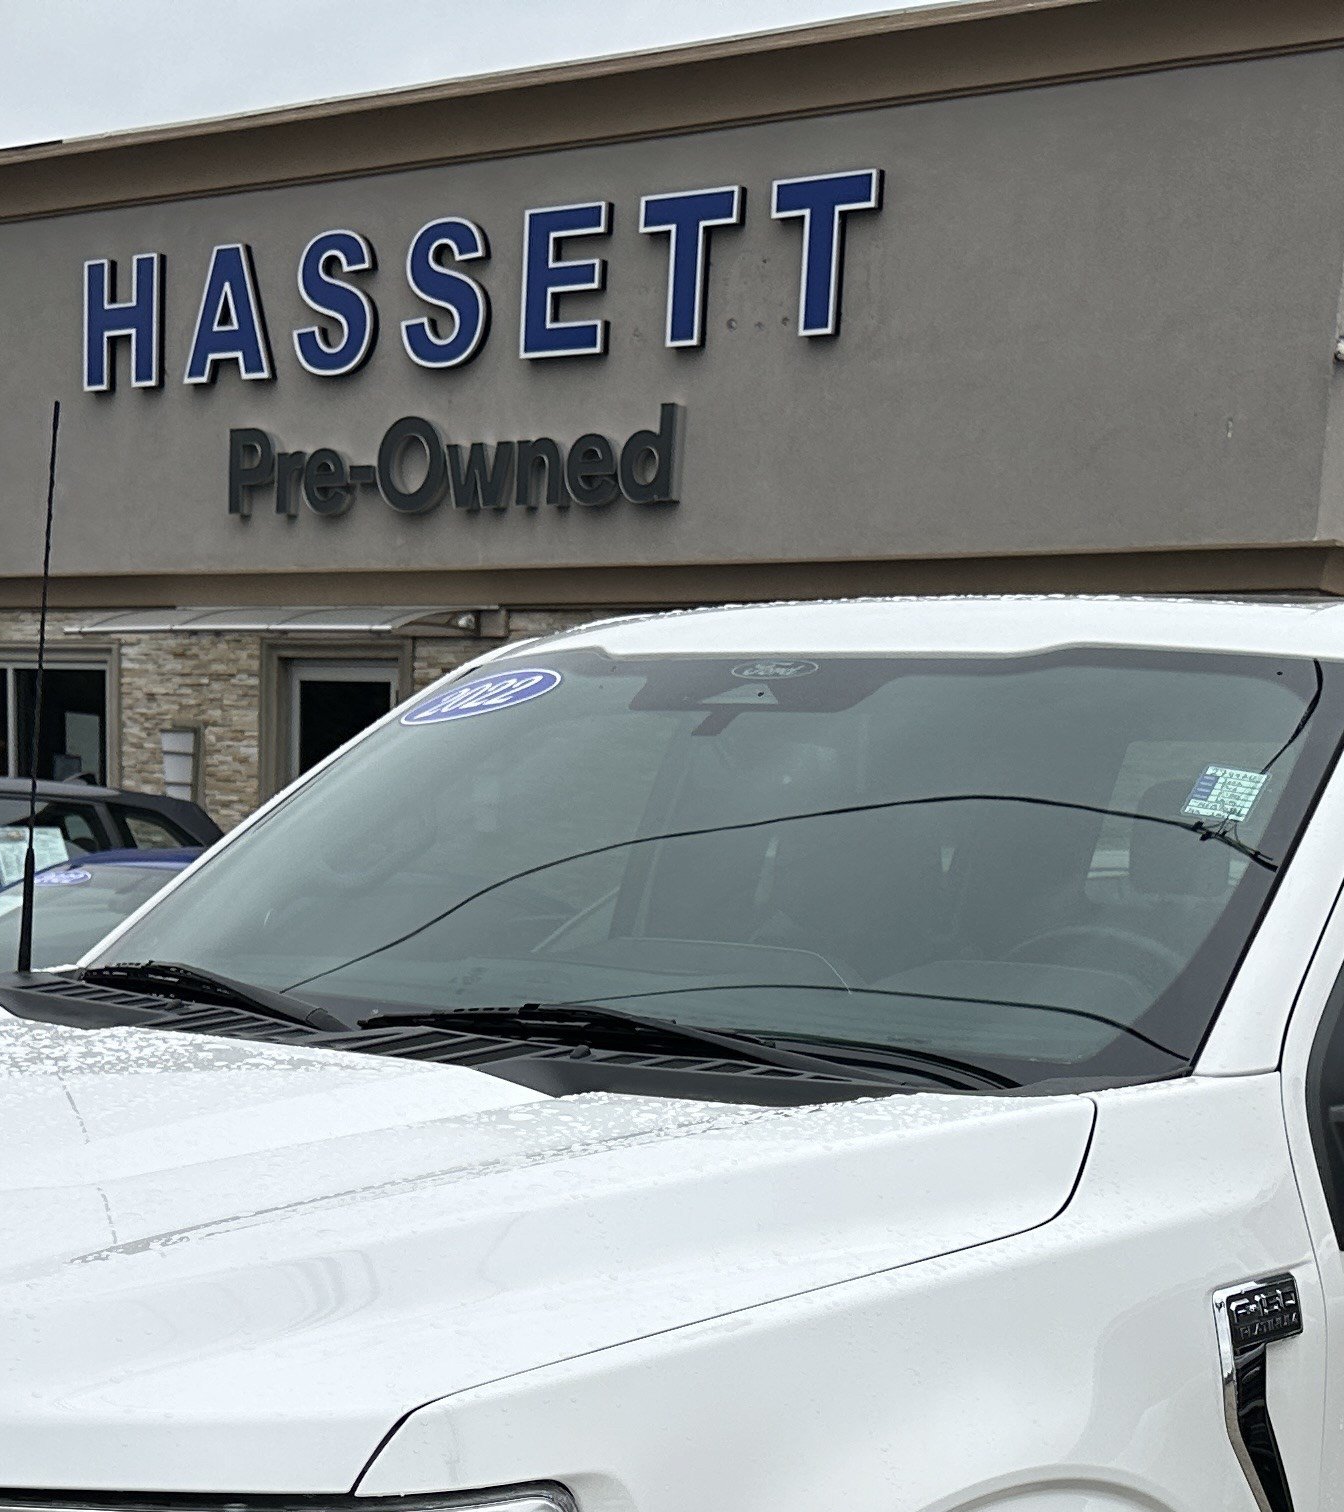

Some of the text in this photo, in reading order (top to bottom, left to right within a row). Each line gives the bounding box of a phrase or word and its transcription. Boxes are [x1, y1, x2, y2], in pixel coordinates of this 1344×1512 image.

[82, 168, 882, 393] HASSETT
[228, 402, 684, 517] Pre-Owned
[414, 674, 544, 719] 2022
